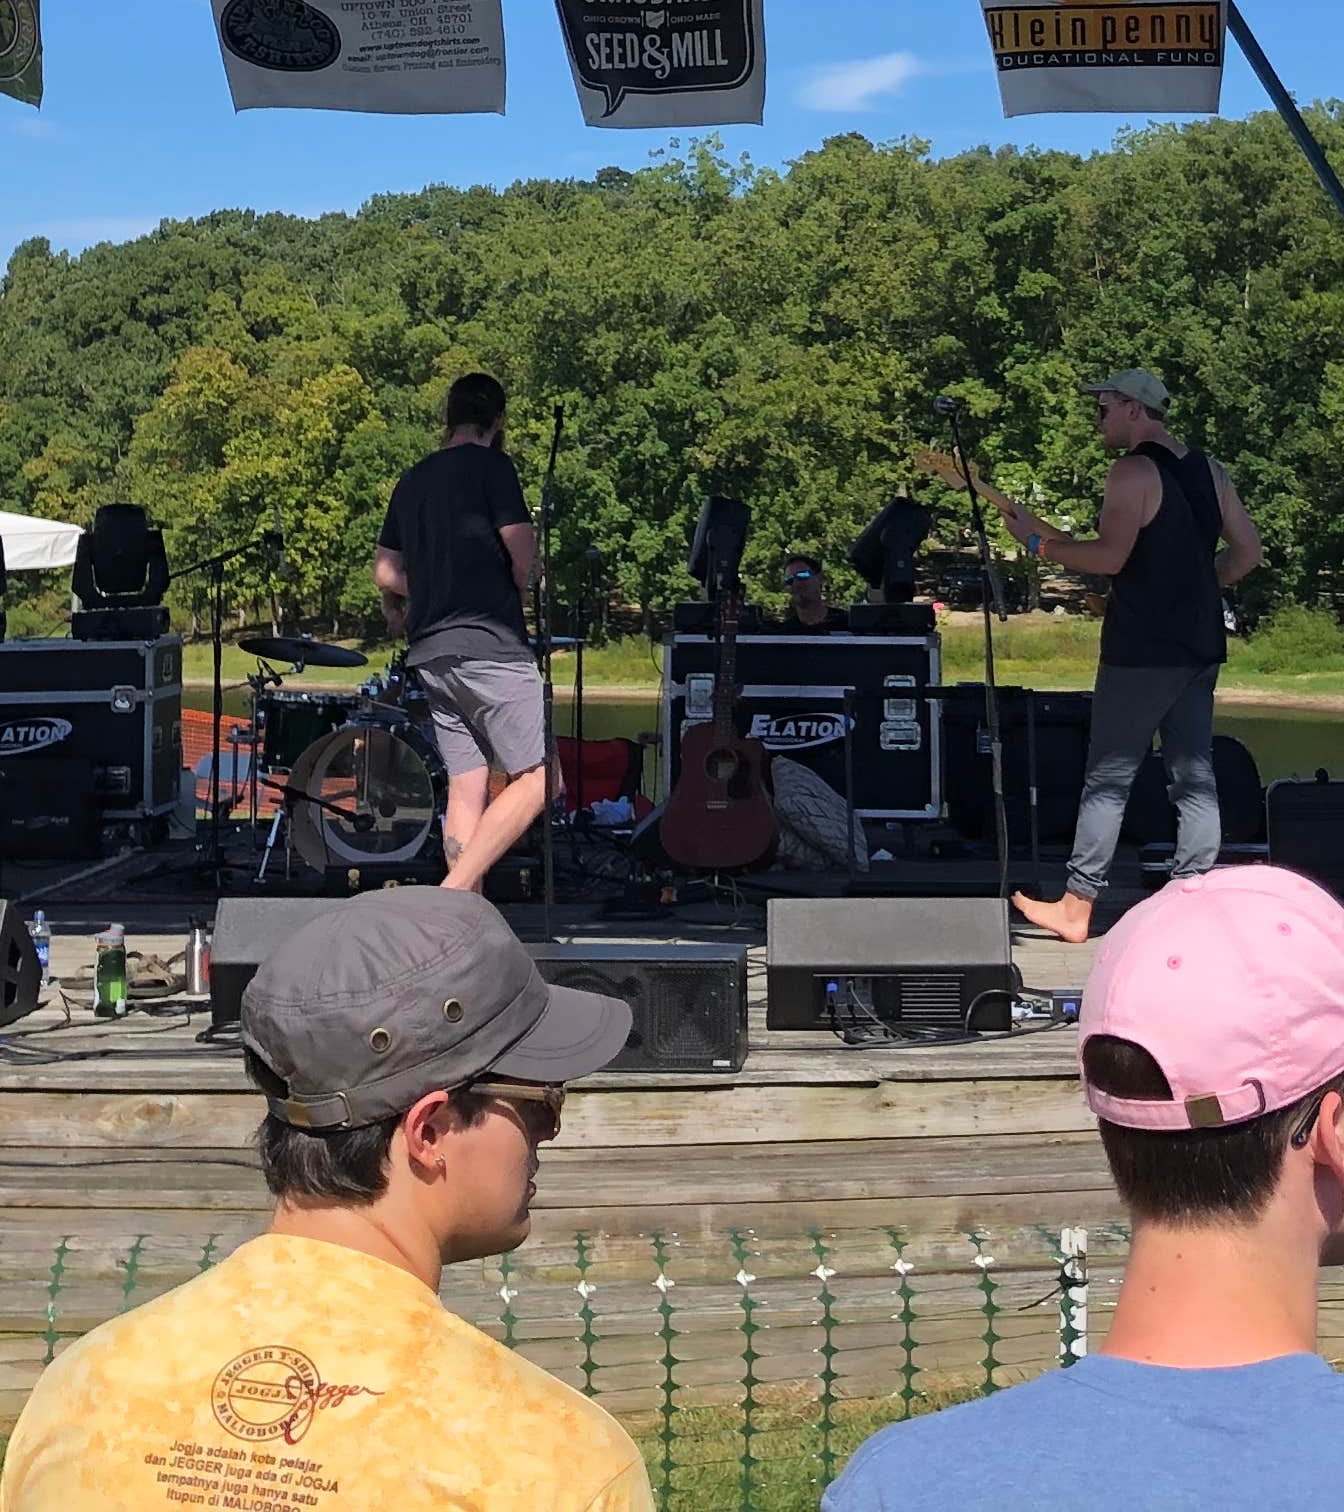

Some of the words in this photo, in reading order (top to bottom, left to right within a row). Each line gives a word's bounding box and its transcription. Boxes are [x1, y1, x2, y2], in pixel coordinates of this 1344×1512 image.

[341, 0, 396, 12] UPTOWN
[399, 6, 433, 18] Union
[437, 3, 472, 14] Street
[1157, 51, 1216, 63] FUND
[169, 1440, 203, 1457] Jogja
[206, 1447, 247, 1462] adalah
[250, 1451, 276, 1465] kota
[279, 1457, 323, 1473] pelajar
[144, 1453, 167, 1466] dan
[169, 1456, 223, 1474] JEGGER
[224, 1463, 252, 1480] juga
[255, 1470, 277, 1482] ada
[280, 1473, 293, 1484] di
[295, 1475, 338, 1493] JOGJA
[156, 1471, 219, 1491] tempatnya
[220, 1479, 249, 1495] juga
[252, 1484, 288, 1501] hanya
[291, 1493, 318, 1506] satu
[208, 1494, 220, 1506] di
